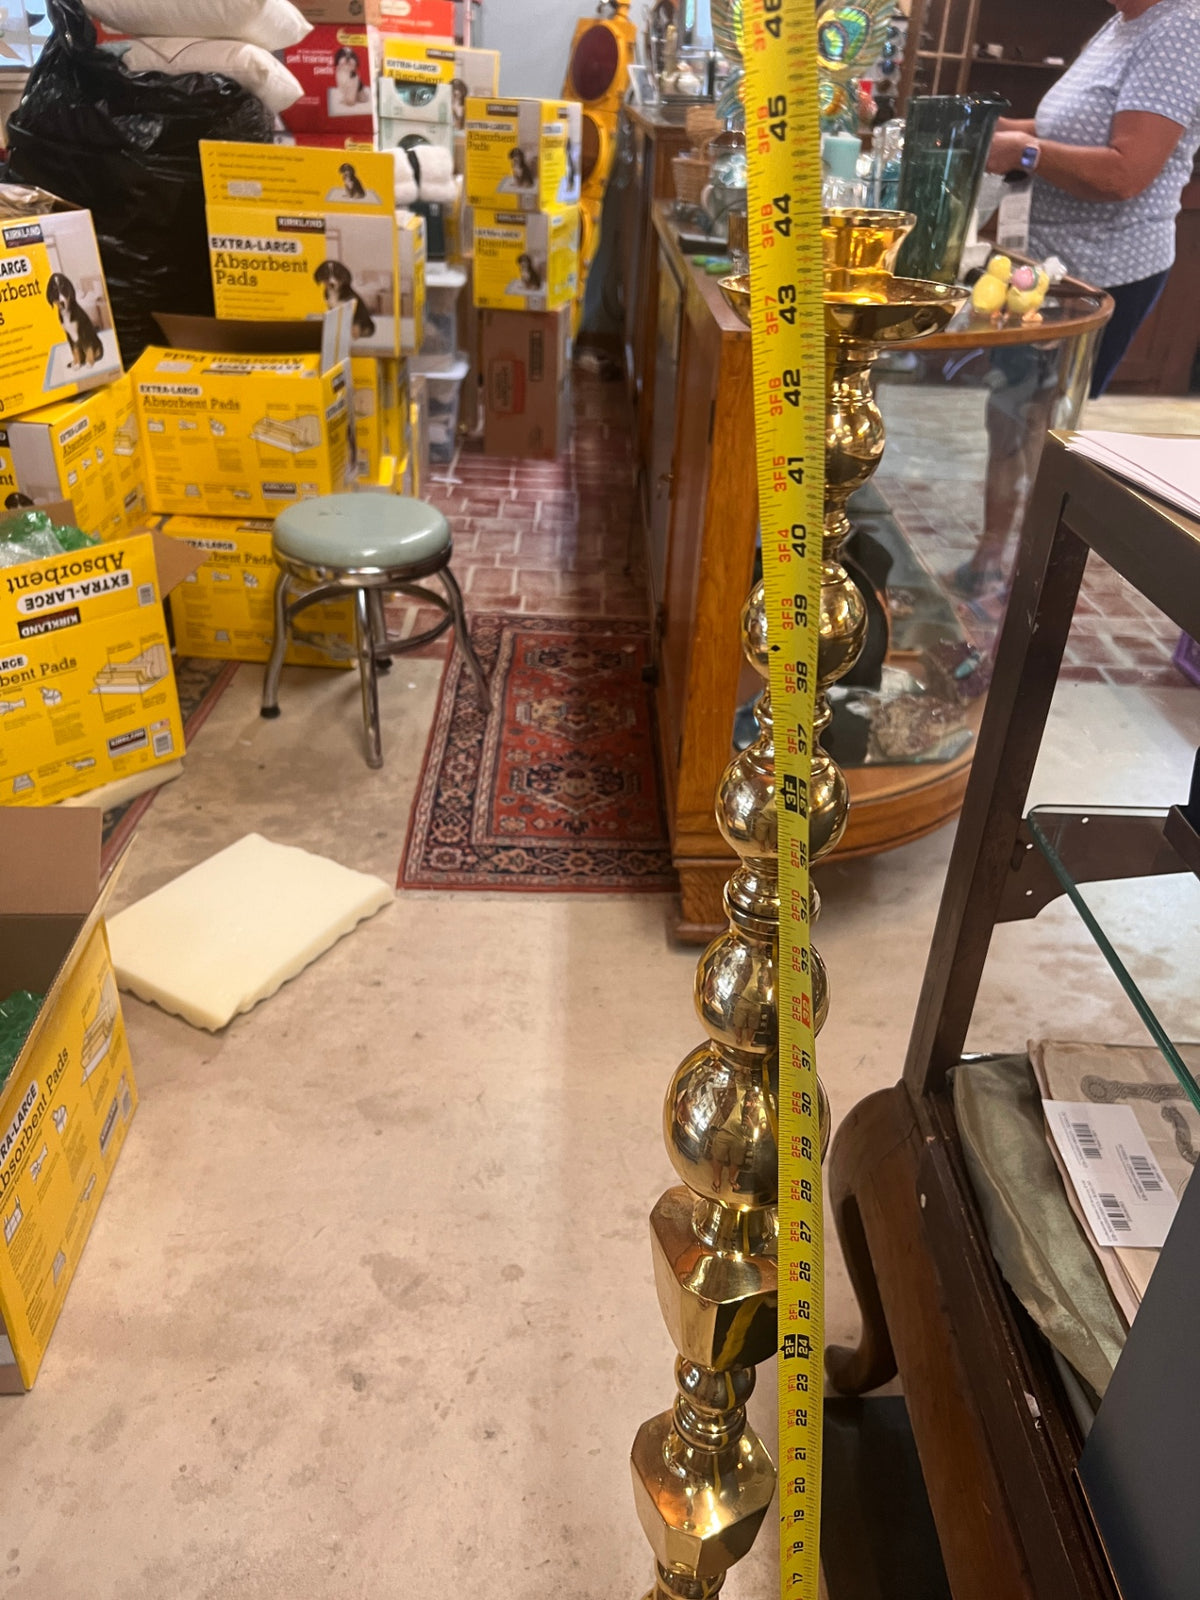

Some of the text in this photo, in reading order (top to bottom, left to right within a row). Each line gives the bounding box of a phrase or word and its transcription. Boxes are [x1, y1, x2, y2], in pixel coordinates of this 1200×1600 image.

[387, 59, 438, 73] EXTRA-LARGE
[768, 95, 787, 142] 45
[278, 217, 323, 229] KIRKLAND
[773, 194, 792, 237] 44
[4, 226, 42, 241] KIRKLAND
[211, 237, 297, 253] EXTRA-LARGE
[214, 253, 309, 274] Absorbent
[215, 270, 258, 288] Pads
[779, 284, 798, 326] 43
[139, 385, 199, 396] EXTRA-LARGE
[783, 369, 802, 408] 42
[143, 396, 240, 410] Absorbent Pads
[788, 457, 804, 485] 41
[791, 524, 806, 558] 40
[7, 551, 124, 595] Absorbent
[25, 573, 130, 611] EXTRA-LARGE
[794, 594, 807, 628] 39
[21, 614, 79, 637] KIRKLAND
[40, 657, 77, 676] Pads
[796, 661, 808, 693] 38
[797, 723, 809, 756] 37
[785, 781, 797, 807] 3F
[46, 1047, 69, 1095] Pads
[801, 1050, 812, 1072] 31
[801, 1092, 812, 1117] 30
[0, 1084, 36, 1166] RA-LARGE
[801, 1136, 812, 1162] 29
[800, 1178, 812, 1203] 28
[799, 1220, 812, 1244] 27
[799, 1260, 811, 1283] 26
[798, 1299, 810, 1320] 25
[785, 1338, 795, 1356] 2F
[798, 1338, 808, 1356] 24
[796, 1373, 808, 1392] 23
[795, 1408, 808, 1427] 22
[794, 1447, 806, 1461] 21
[794, 1477, 805, 1494] 20
[793, 1509, 804, 1523] 19
[792, 1541, 804, 1554] 18
[792, 1572, 803, 1585] 17
